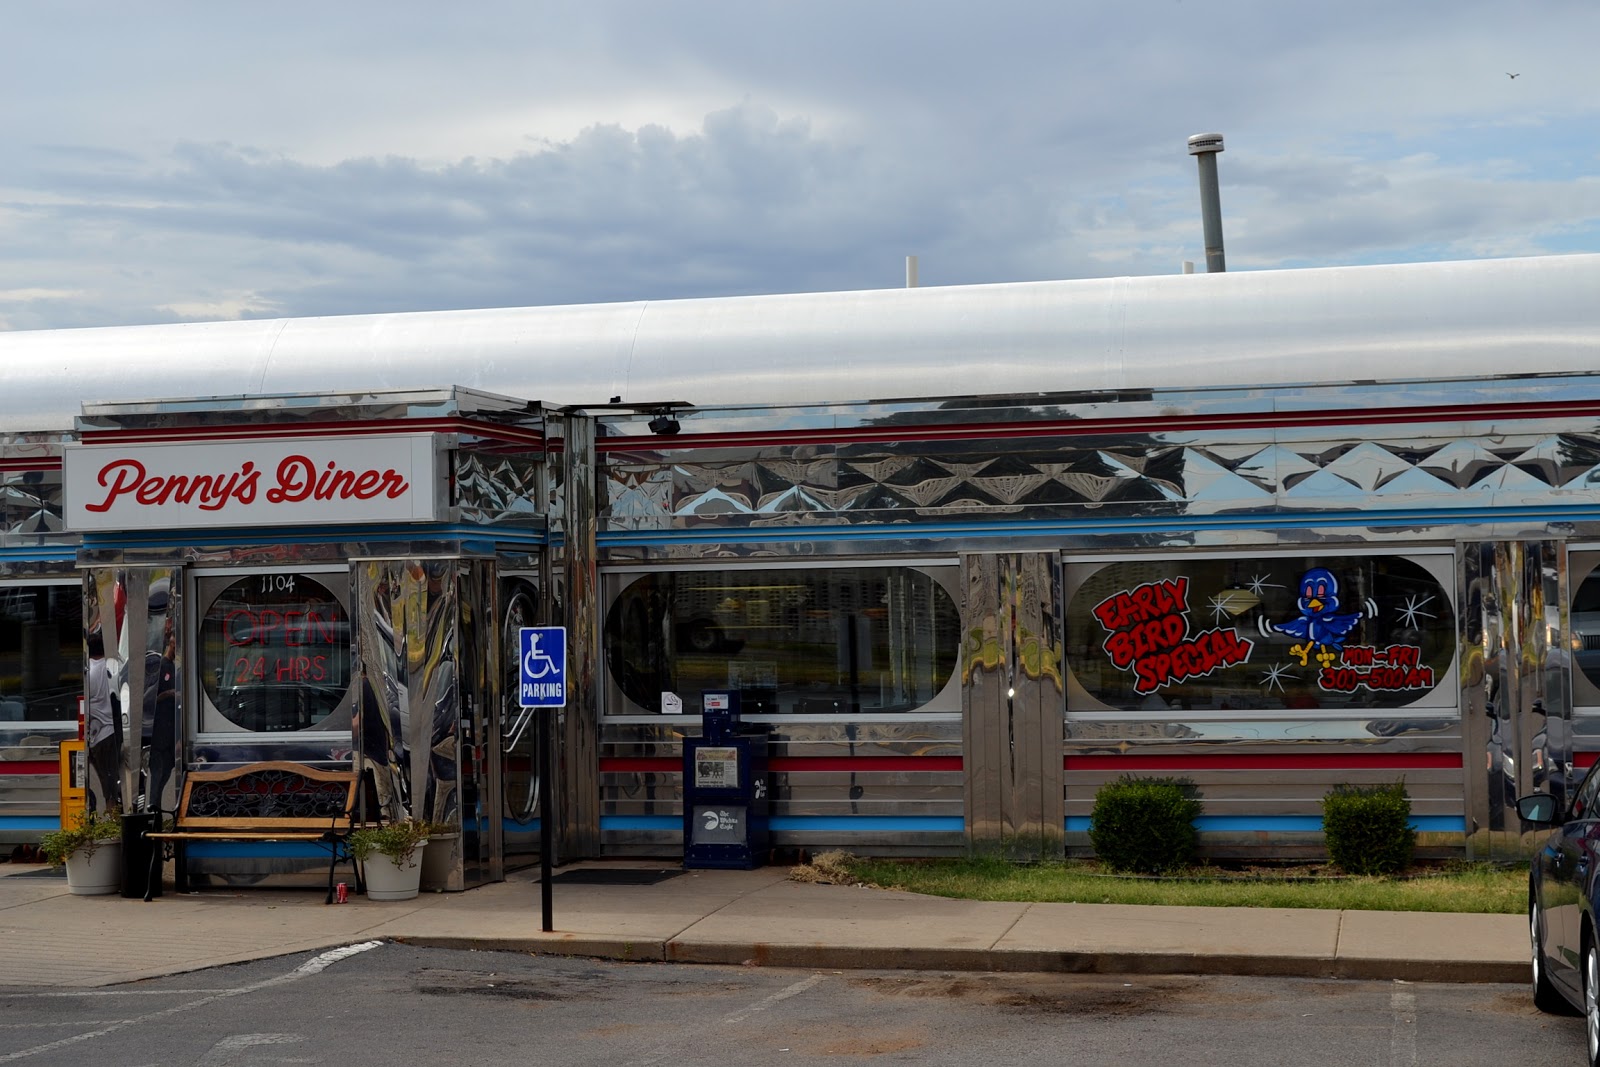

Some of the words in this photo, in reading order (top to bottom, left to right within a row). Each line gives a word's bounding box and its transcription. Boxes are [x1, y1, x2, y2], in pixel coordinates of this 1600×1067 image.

[85, 459, 261, 513] Penny's
[265, 454, 409, 504] Diner
[261, 575, 295, 593] 1104
[1094, 577, 1189, 630] EARLY
[223, 609, 337, 646] OPEN
[1105, 613, 1186, 668] BIRD
[235, 657, 265, 683] 24
[276, 655, 326, 682] HRS
[1135, 629, 1252, 693] SPECIAL
[522, 683, 562, 698] PARKING
